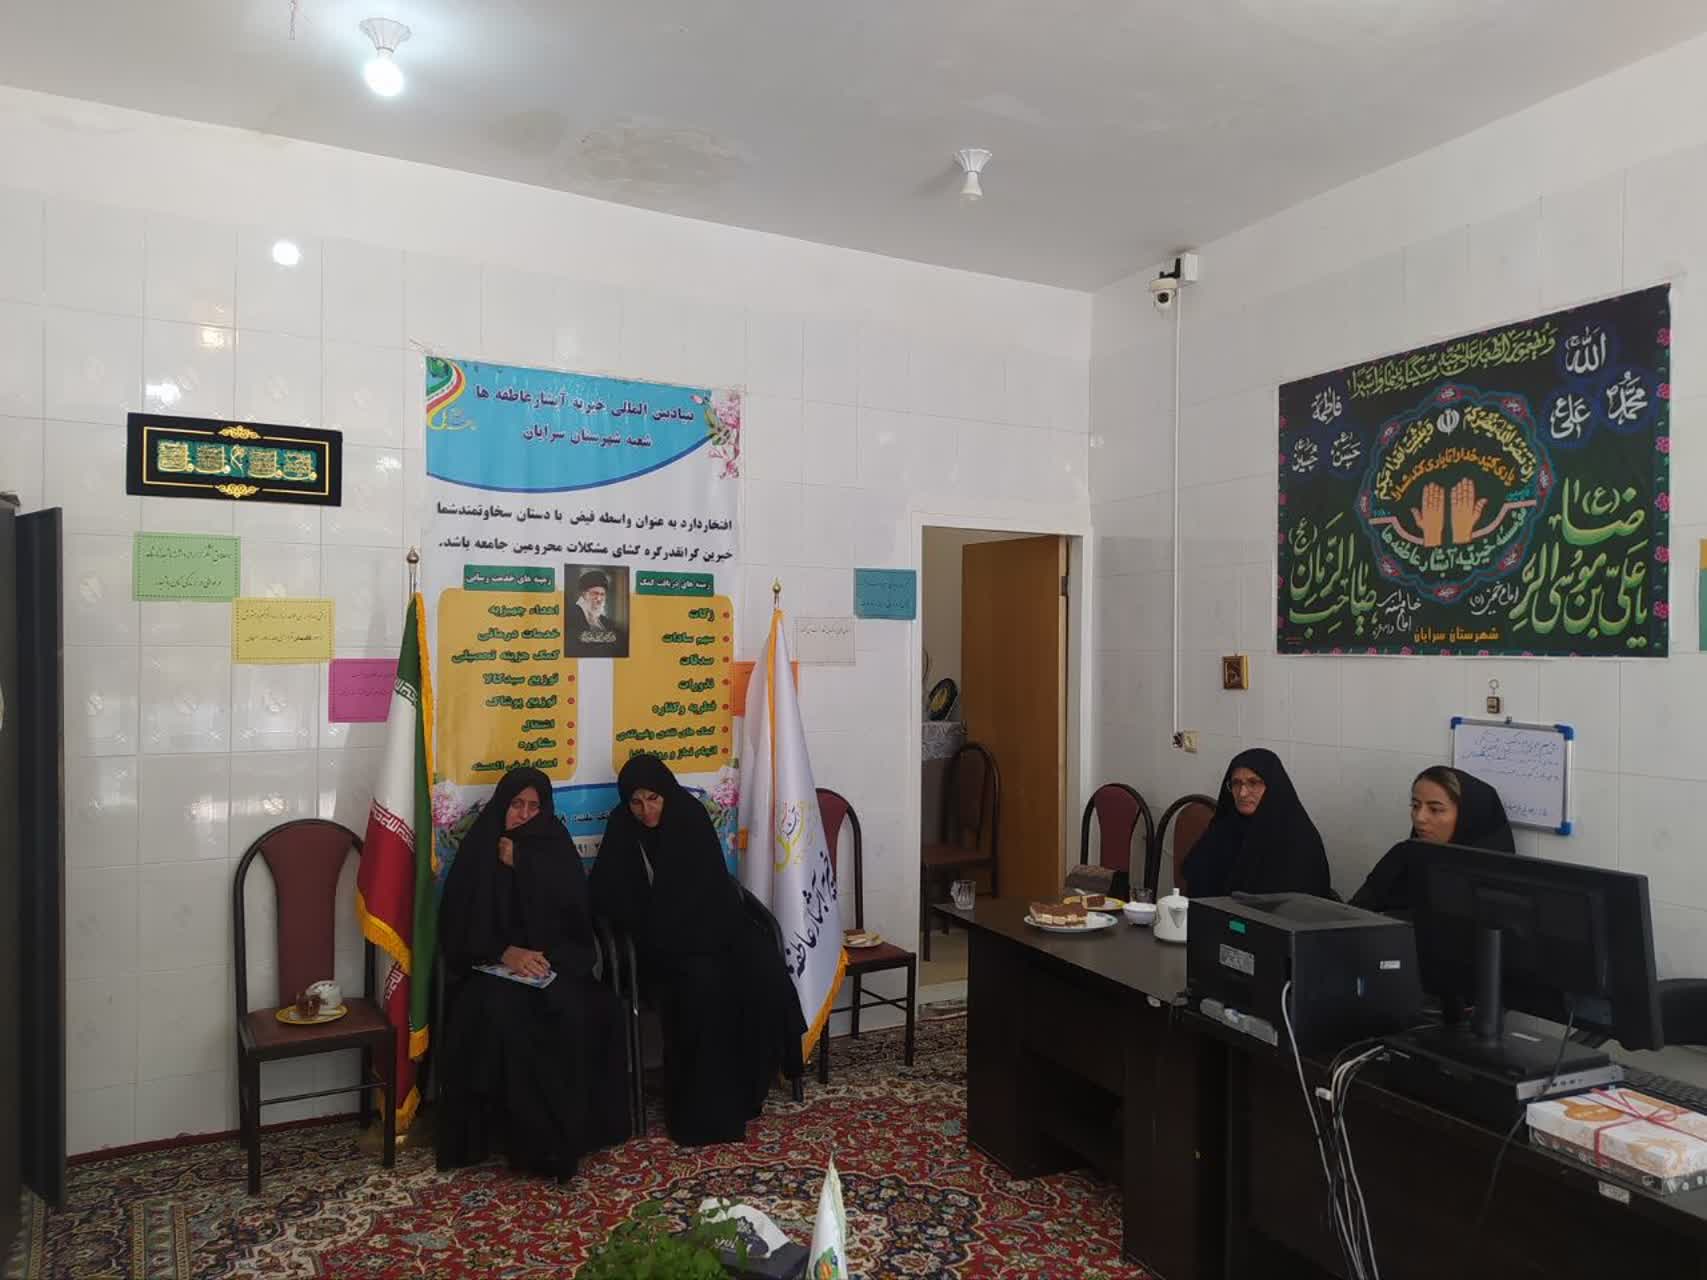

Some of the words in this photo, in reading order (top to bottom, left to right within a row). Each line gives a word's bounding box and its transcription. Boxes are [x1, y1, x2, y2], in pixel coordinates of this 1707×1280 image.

[523, 424, 565, 441] سرایان
[570, 428, 622, 447] شهرستان
[516, 507, 550, 522] دستان
[554, 510, 564, 521] با
[569, 512, 596, 527] فیض
[598, 511, 632, 529] واسطه
[635, 515, 664, 530] عنوان
[667, 519, 677, 530] به
[473, 538, 509, 552] جامعه
[512, 540, 563, 558] محرومین
[566, 540, 609, 557] مشکلات
[702, 548, 733, 564] خیرین
[1413, 626, 1446, 643] سرایان
[1448, 626, 1500, 643] شهرستان
